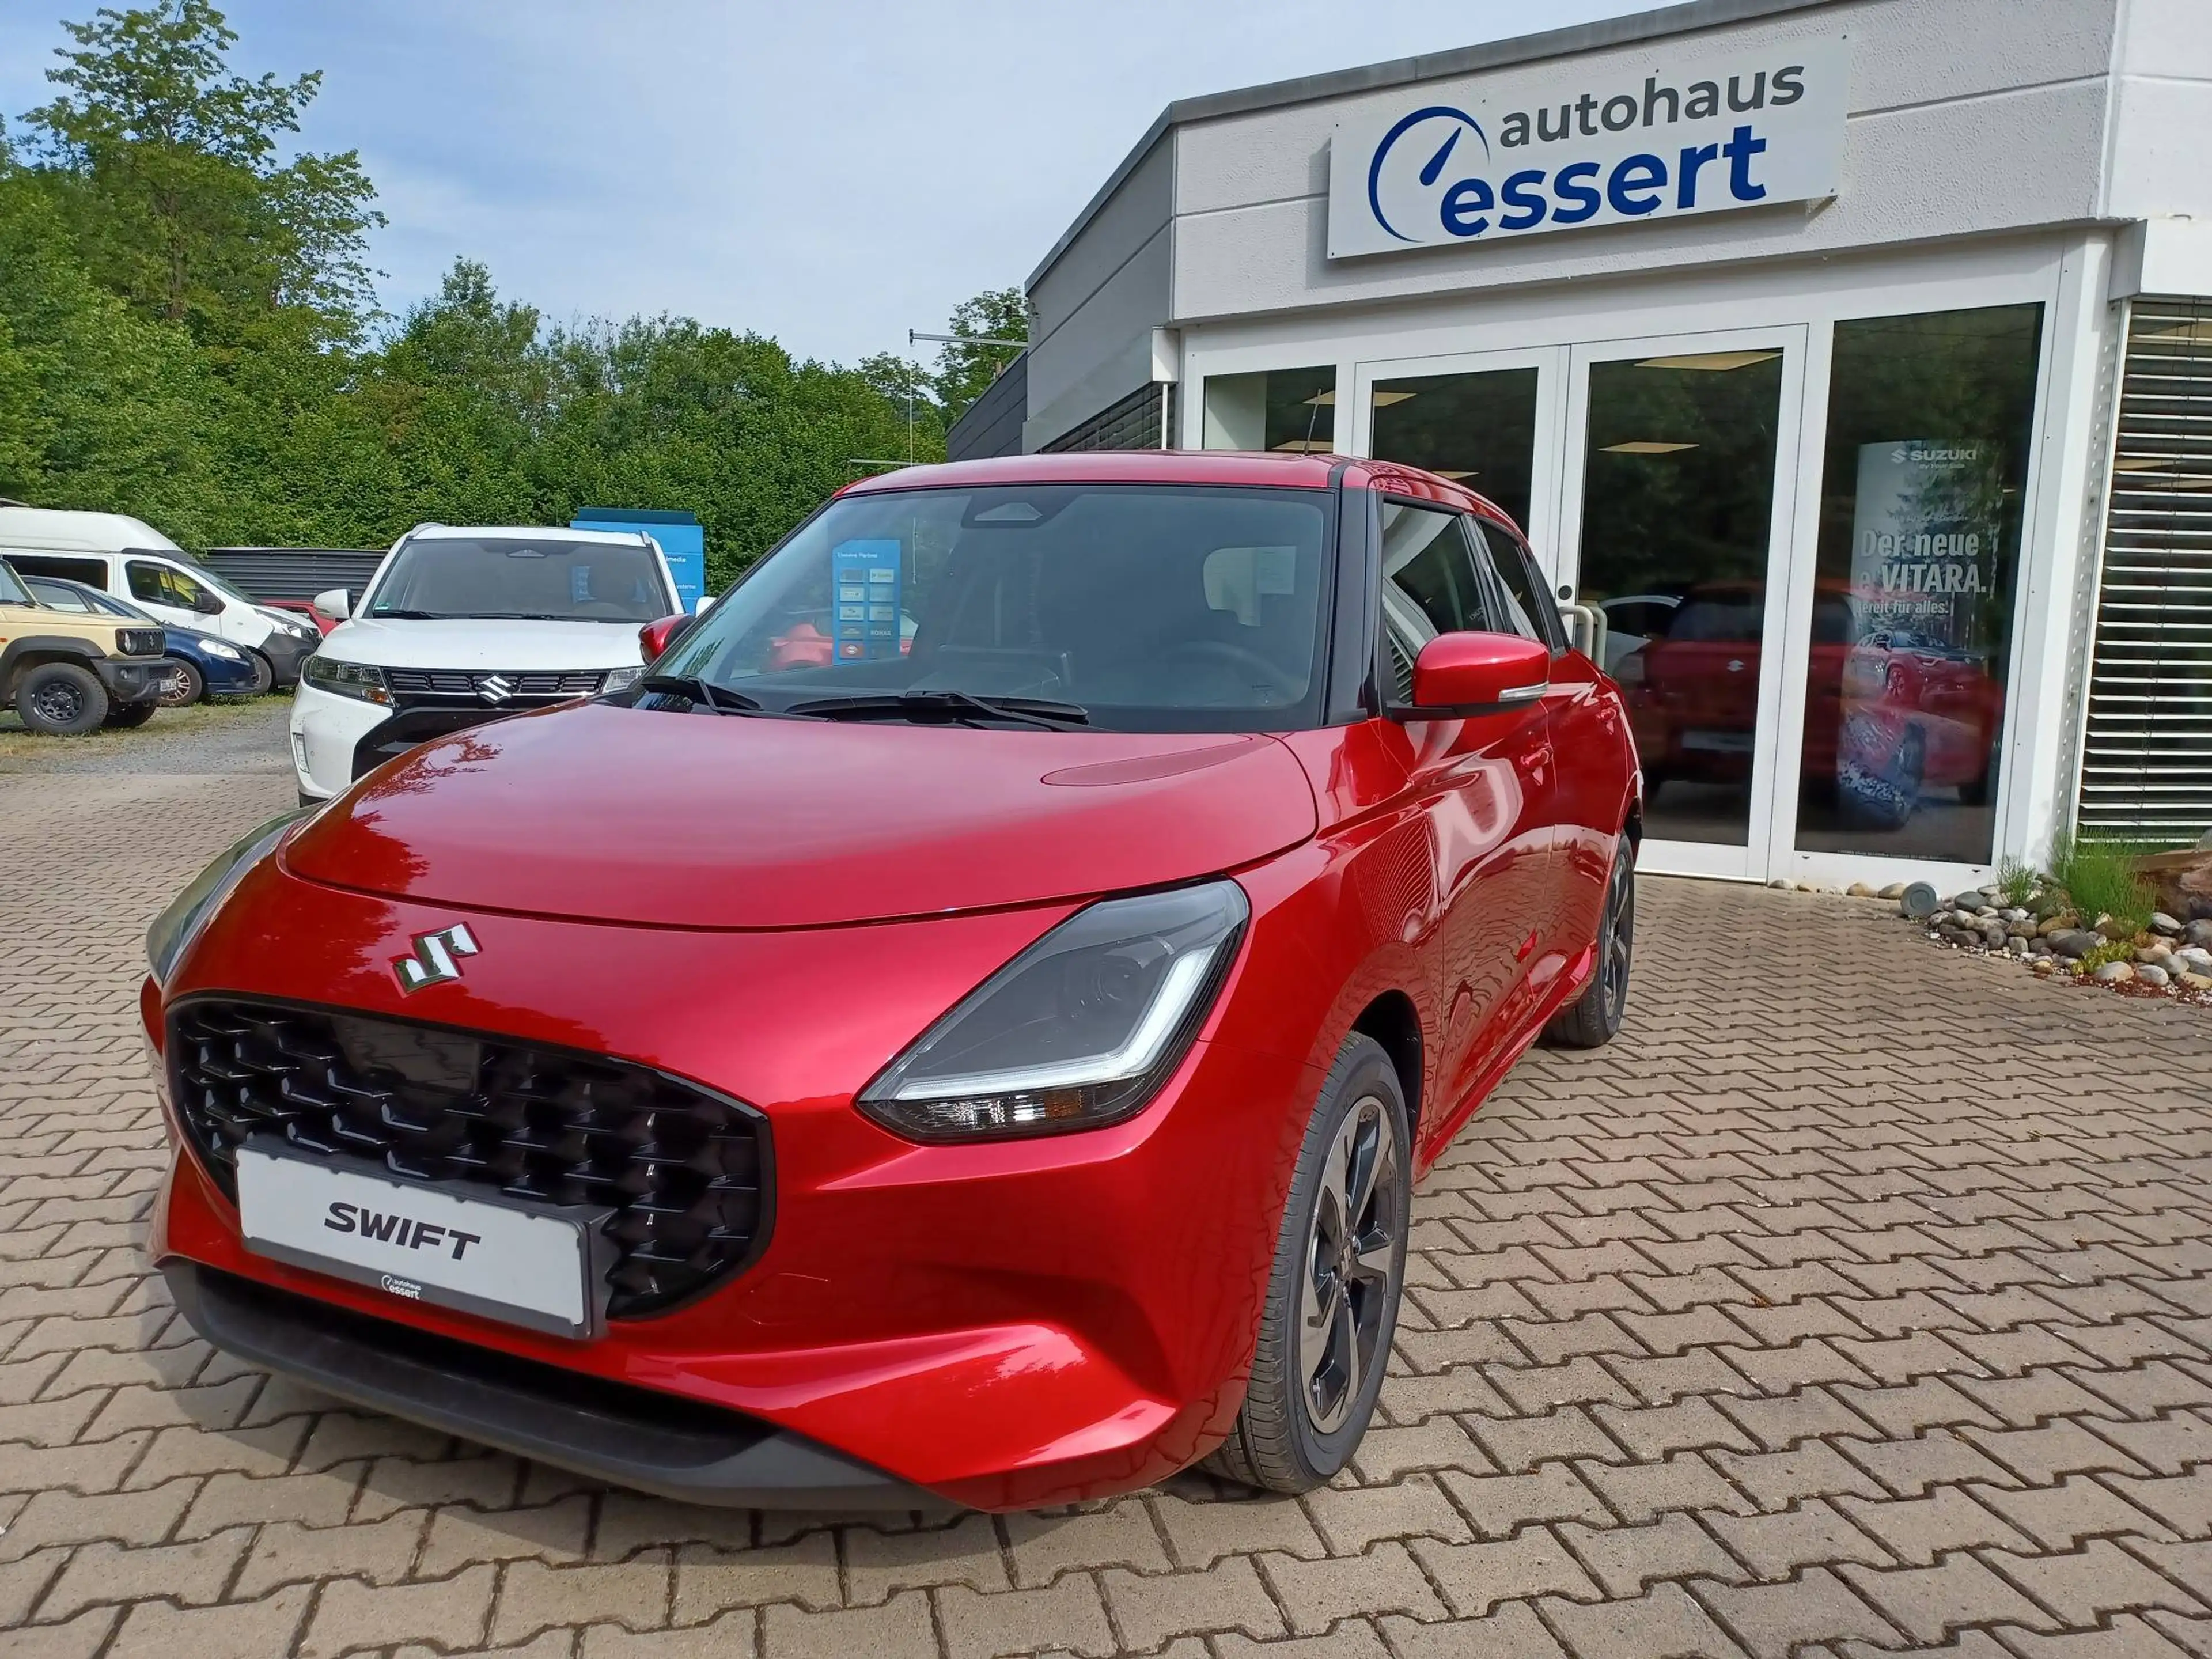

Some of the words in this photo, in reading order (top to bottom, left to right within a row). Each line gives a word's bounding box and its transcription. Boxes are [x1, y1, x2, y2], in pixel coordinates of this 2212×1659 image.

[1499, 65, 1805, 149] autohaus
[1439, 124, 1767, 237] essert
[1910, 449, 1977, 461] SUZUKI
[1861, 529, 1905, 557] Der
[1914, 531, 1979, 557] neue
[1881, 563, 1987, 593] VITARA.
[1893, 600, 1912, 613] für
[324, 1202, 481, 1261] SWIFT
[389, 1285, 420, 1300] essert
